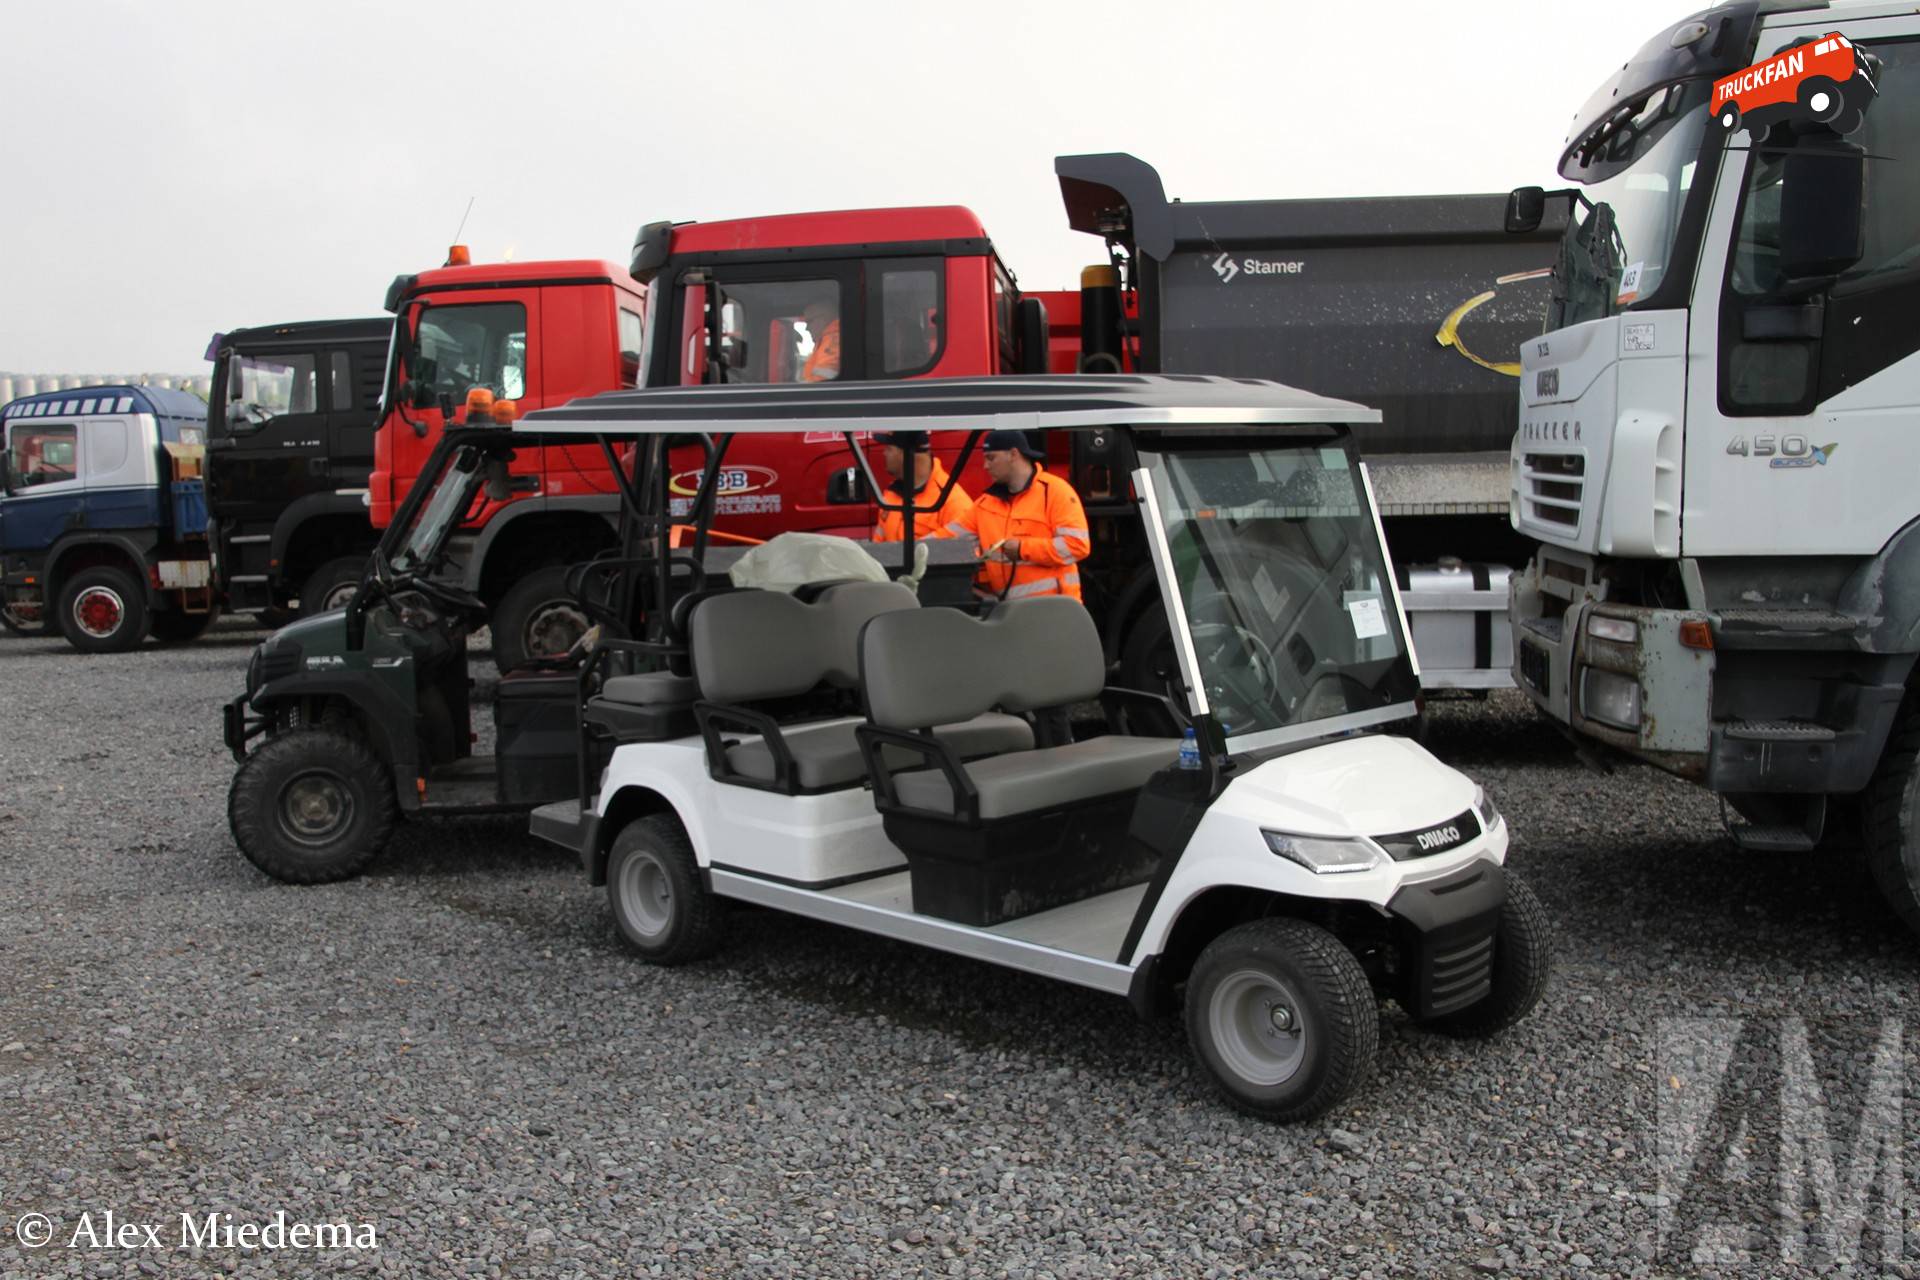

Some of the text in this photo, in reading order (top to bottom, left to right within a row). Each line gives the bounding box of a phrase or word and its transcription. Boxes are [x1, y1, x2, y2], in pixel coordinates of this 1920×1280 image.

[1243, 258, 1304, 275] Stamer
[1726, 434, 1807, 457] 450
[1416, 826, 1460, 850] DIVACO
